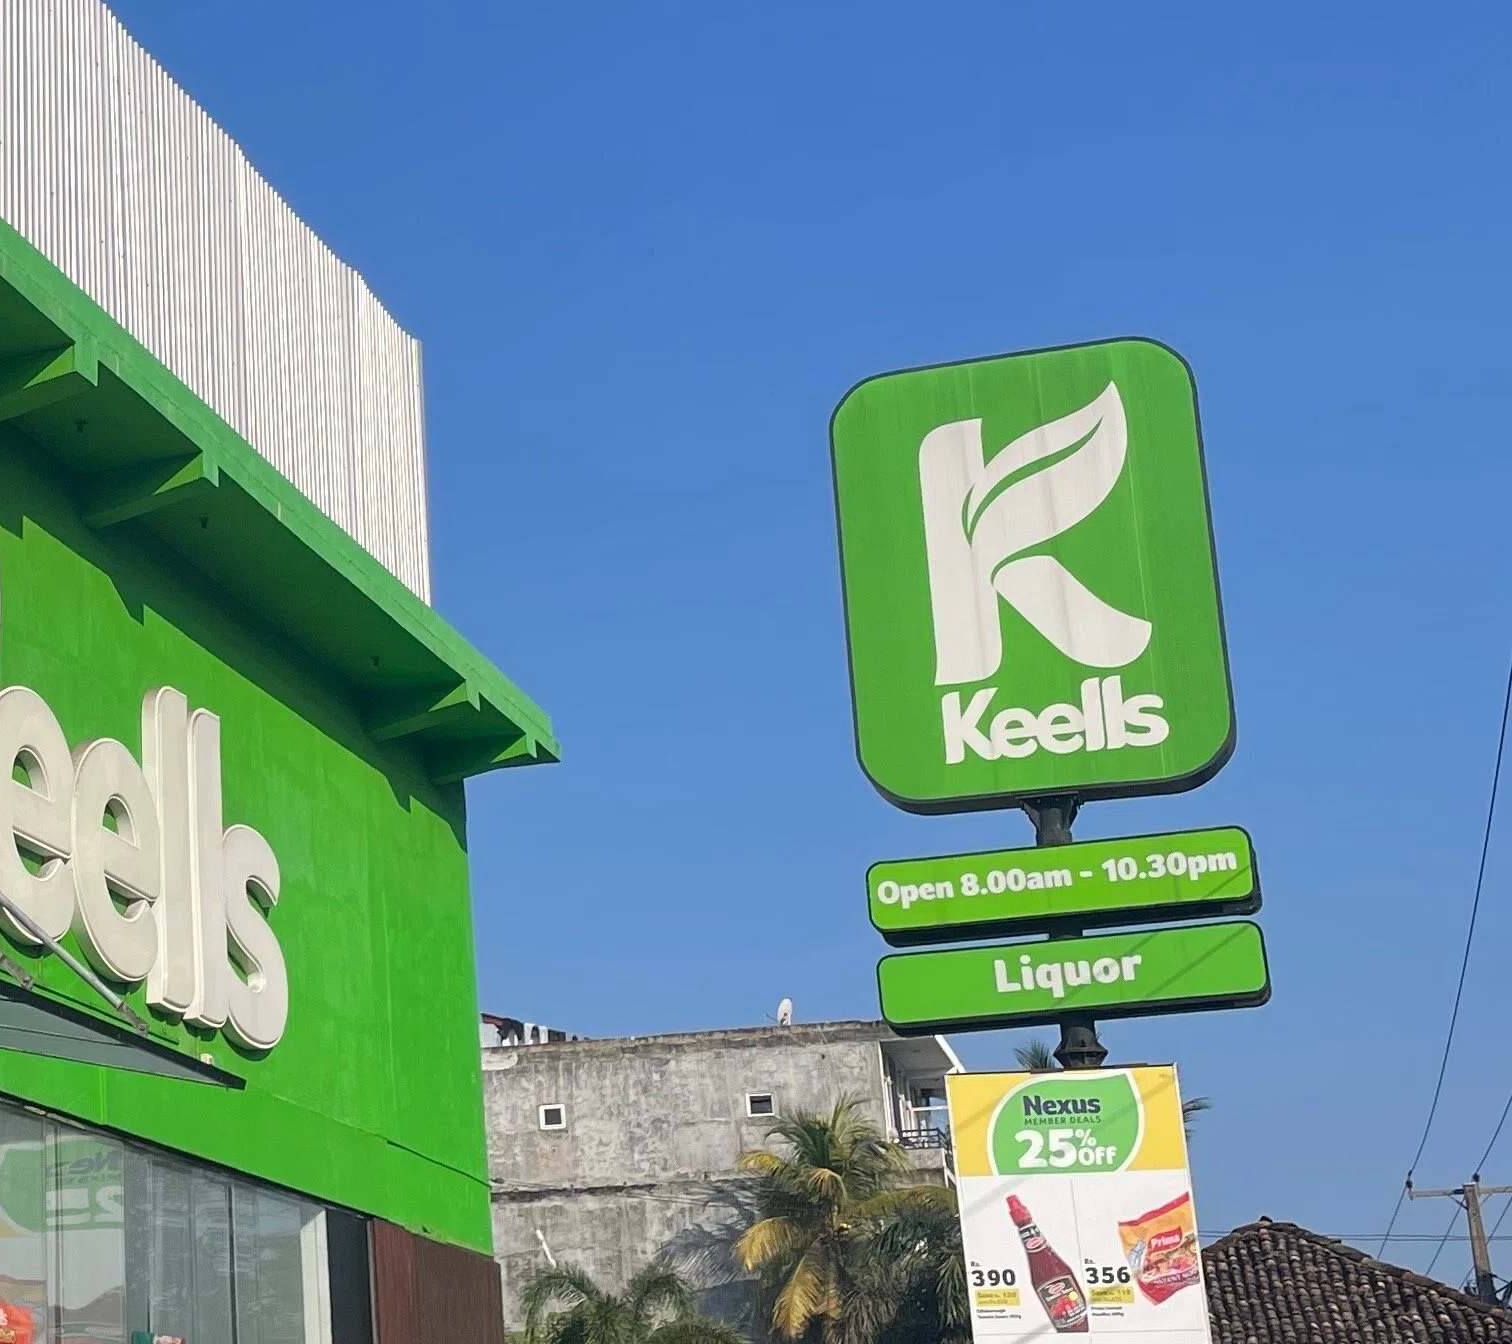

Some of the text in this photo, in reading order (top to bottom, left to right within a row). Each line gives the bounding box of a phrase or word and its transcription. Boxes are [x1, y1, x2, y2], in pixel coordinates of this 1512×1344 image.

[941, 675, 1170, 764] Keells
[877, 878, 955, 912] Open
[959, 864, 1074, 898] 8.00am
[1101, 850, 1238, 885] 10.30pm
[993, 950, 1143, 999] Liquor
[1022, 1094, 1101, 1116] Nexus
[1024, 1115, 1102, 1126] MEMBER DEALS
[972, 1268, 1016, 1287] 390
[1085, 1266, 1131, 1284] 356
